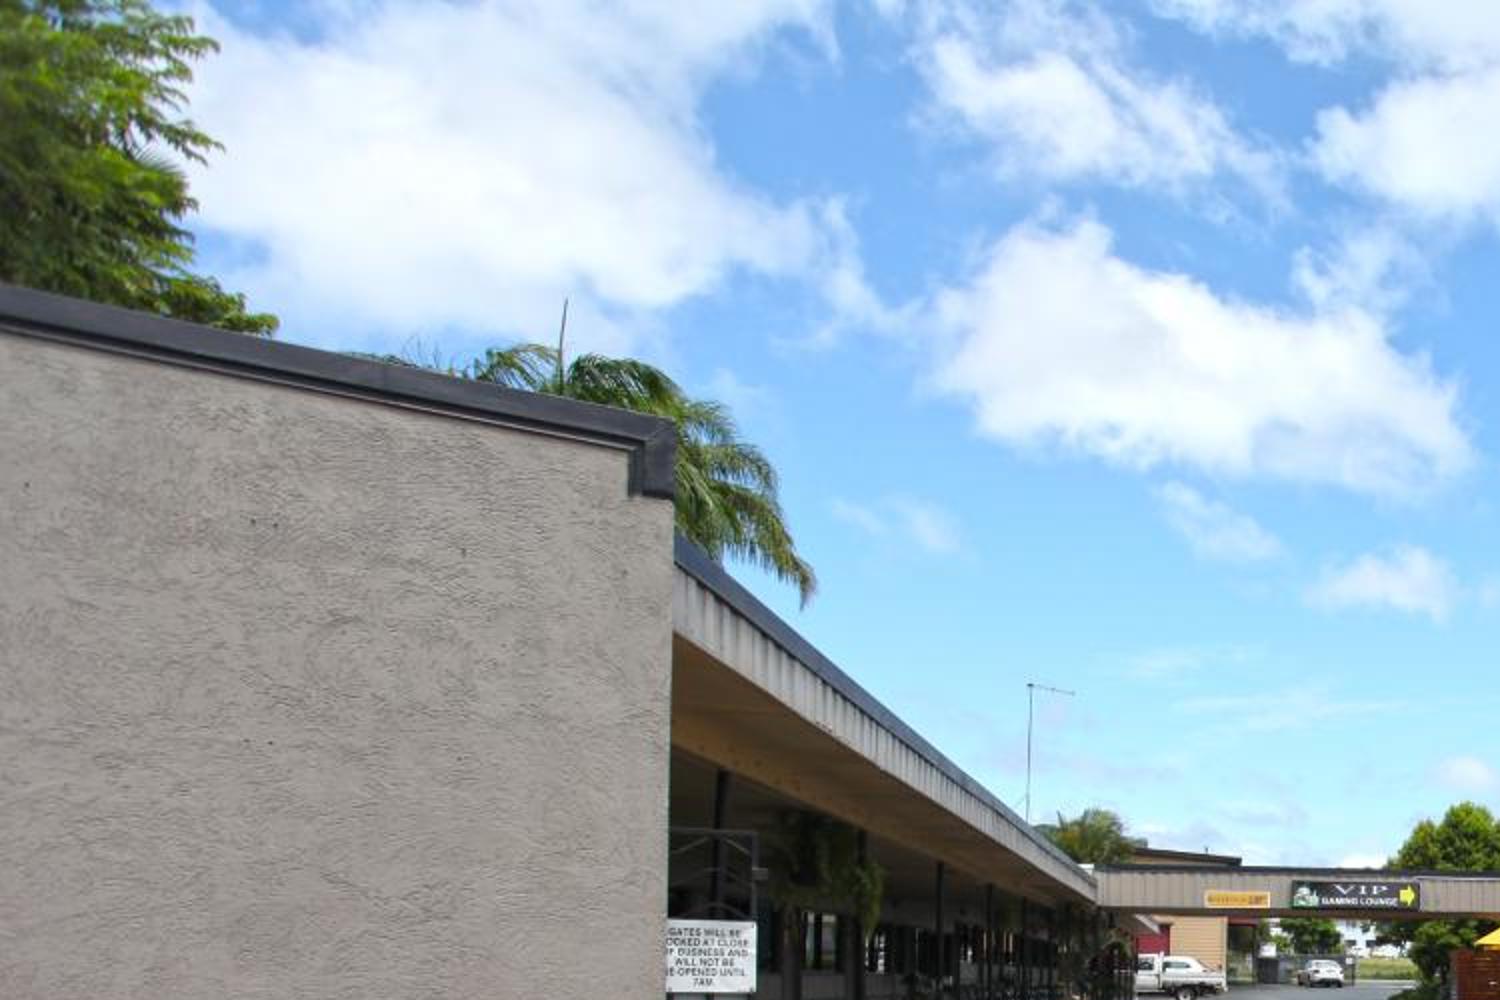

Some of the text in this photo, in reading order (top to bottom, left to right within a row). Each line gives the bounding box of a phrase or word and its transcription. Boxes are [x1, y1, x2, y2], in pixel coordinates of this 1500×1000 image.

[1336, 885, 1389, 895] VIP
[1321, 896, 1398, 907] GAMING LOUNGE
[665, 937, 700, 947] OCKED
[677, 948, 725, 957] BUSINESS
[727, 949, 749, 957] AND
[699, 958, 719, 967] NOT
